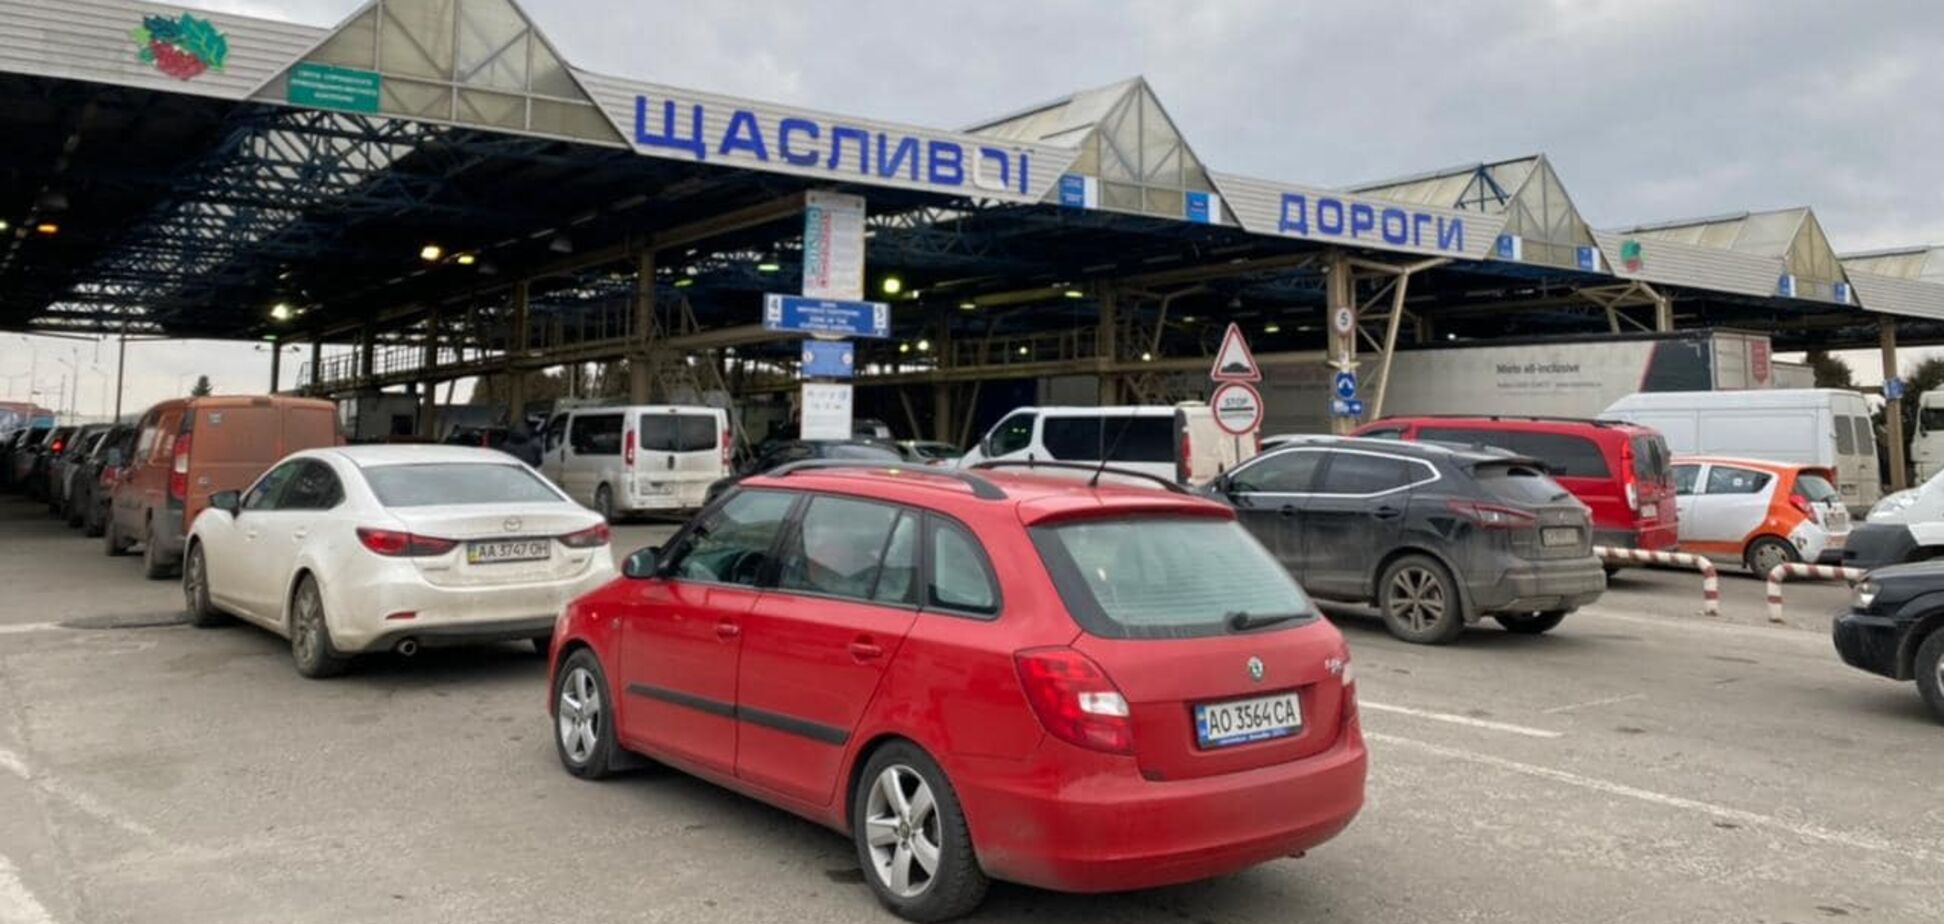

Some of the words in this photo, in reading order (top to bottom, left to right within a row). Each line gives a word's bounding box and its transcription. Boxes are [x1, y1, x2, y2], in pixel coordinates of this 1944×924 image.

[634, 94, 1034, 195] ЩАСЛИВОЇ
[1278, 192, 1464, 252] ДОРОГИ
[1340, 311, 1349, 326] 5
[1225, 397, 1249, 407] STOP
[478, 544, 496, 558] AA
[500, 543, 526, 557] 3747
[1208, 708, 1232, 735] AO
[1236, 703, 1272, 731] 3564
[1273, 698, 1296, 724] CA
